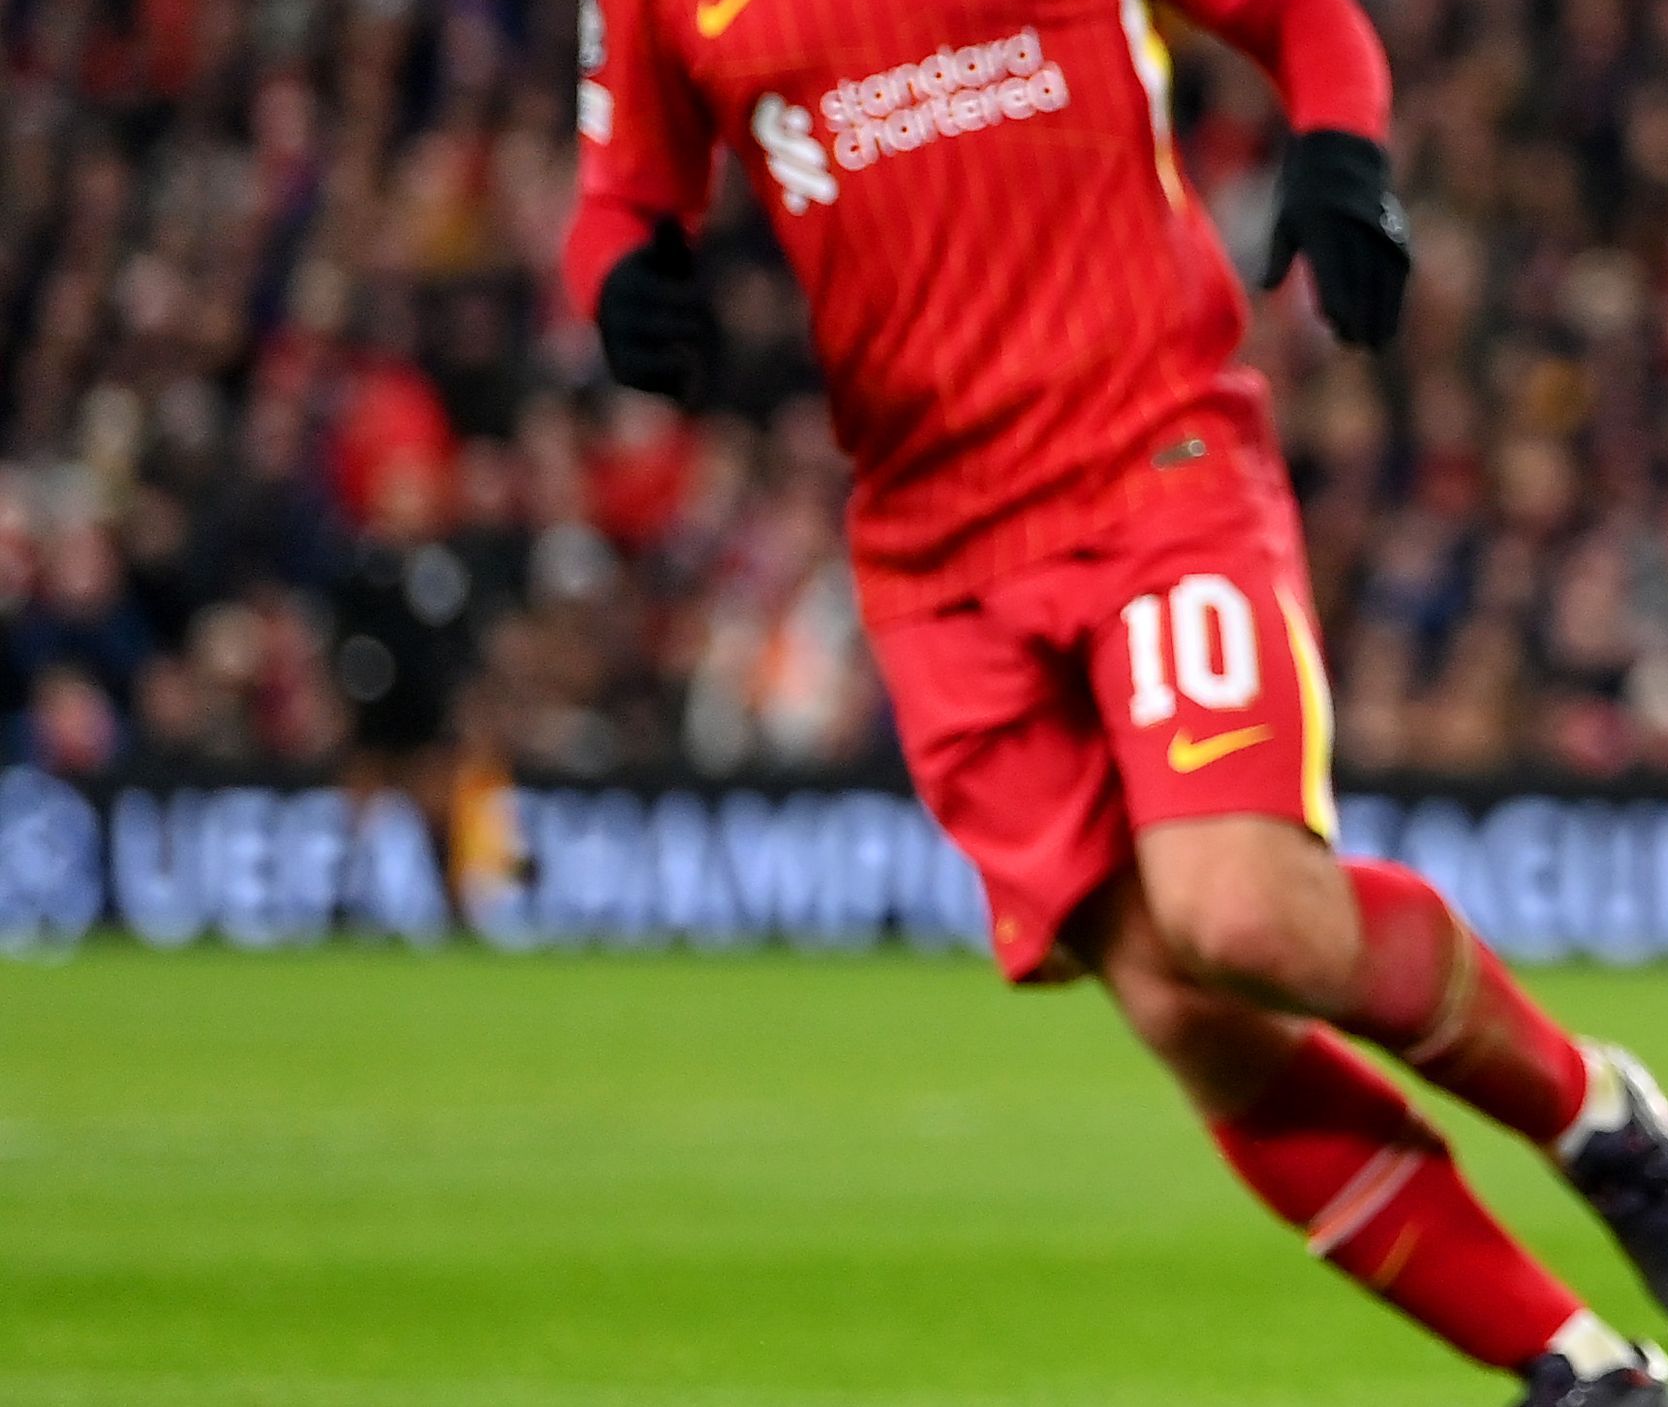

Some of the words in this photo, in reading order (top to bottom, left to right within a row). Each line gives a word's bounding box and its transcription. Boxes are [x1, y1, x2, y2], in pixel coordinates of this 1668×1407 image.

[820, 25, 1043, 133] standard
[834, 60, 1070, 172] chartered
[1119, 572, 1261, 730] 10
[114, 784, 456, 950] UEFA
